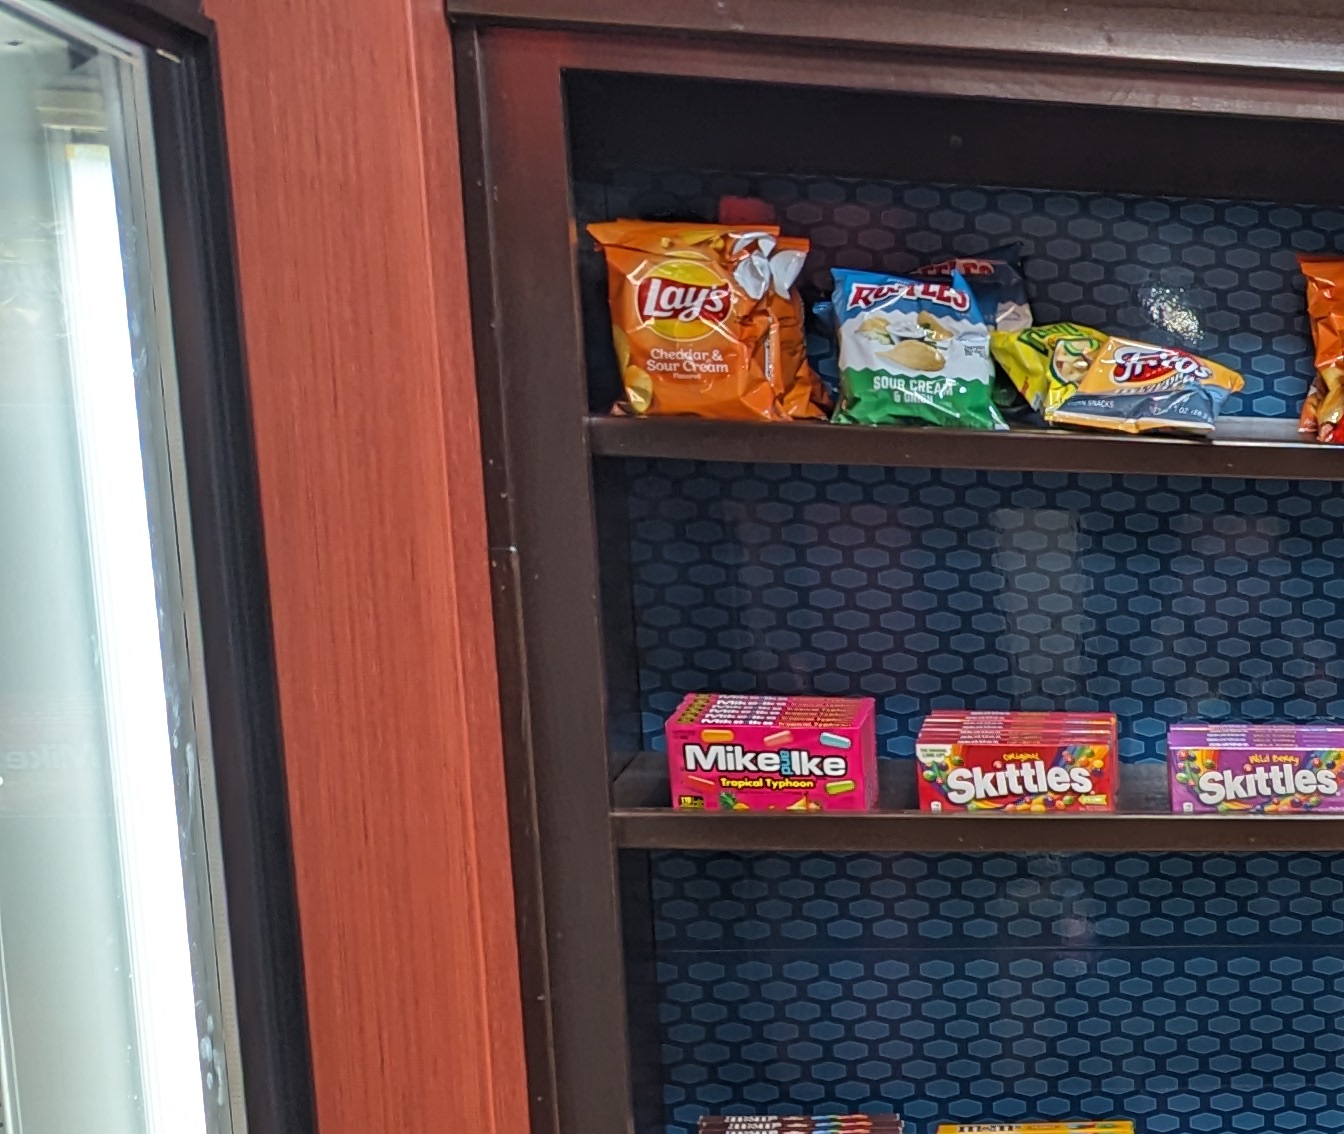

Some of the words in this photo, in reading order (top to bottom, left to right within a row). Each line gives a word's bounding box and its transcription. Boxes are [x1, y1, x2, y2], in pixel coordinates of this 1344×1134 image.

[643, 278, 729, 322] Lay's
[647, 360, 680, 372] Sour
[682, 361, 729, 373] Cream
[650, 348, 709, 361] Cheddar
[712, 349, 723, 361] &
[1113, 346, 1213, 383] Fritos
[873, 375, 905, 391] SOUR
[909, 378, 954, 397] CREAM
[684, 744, 781, 772] Mike
[780, 749, 793, 776] and
[792, 750, 847, 776] Ike
[720, 777, 764, 789] Tropical
[765, 778, 814, 790] Typhoon
[946, 760, 1094, 805] Skittles
[1198, 763, 1339, 805] Skittles
